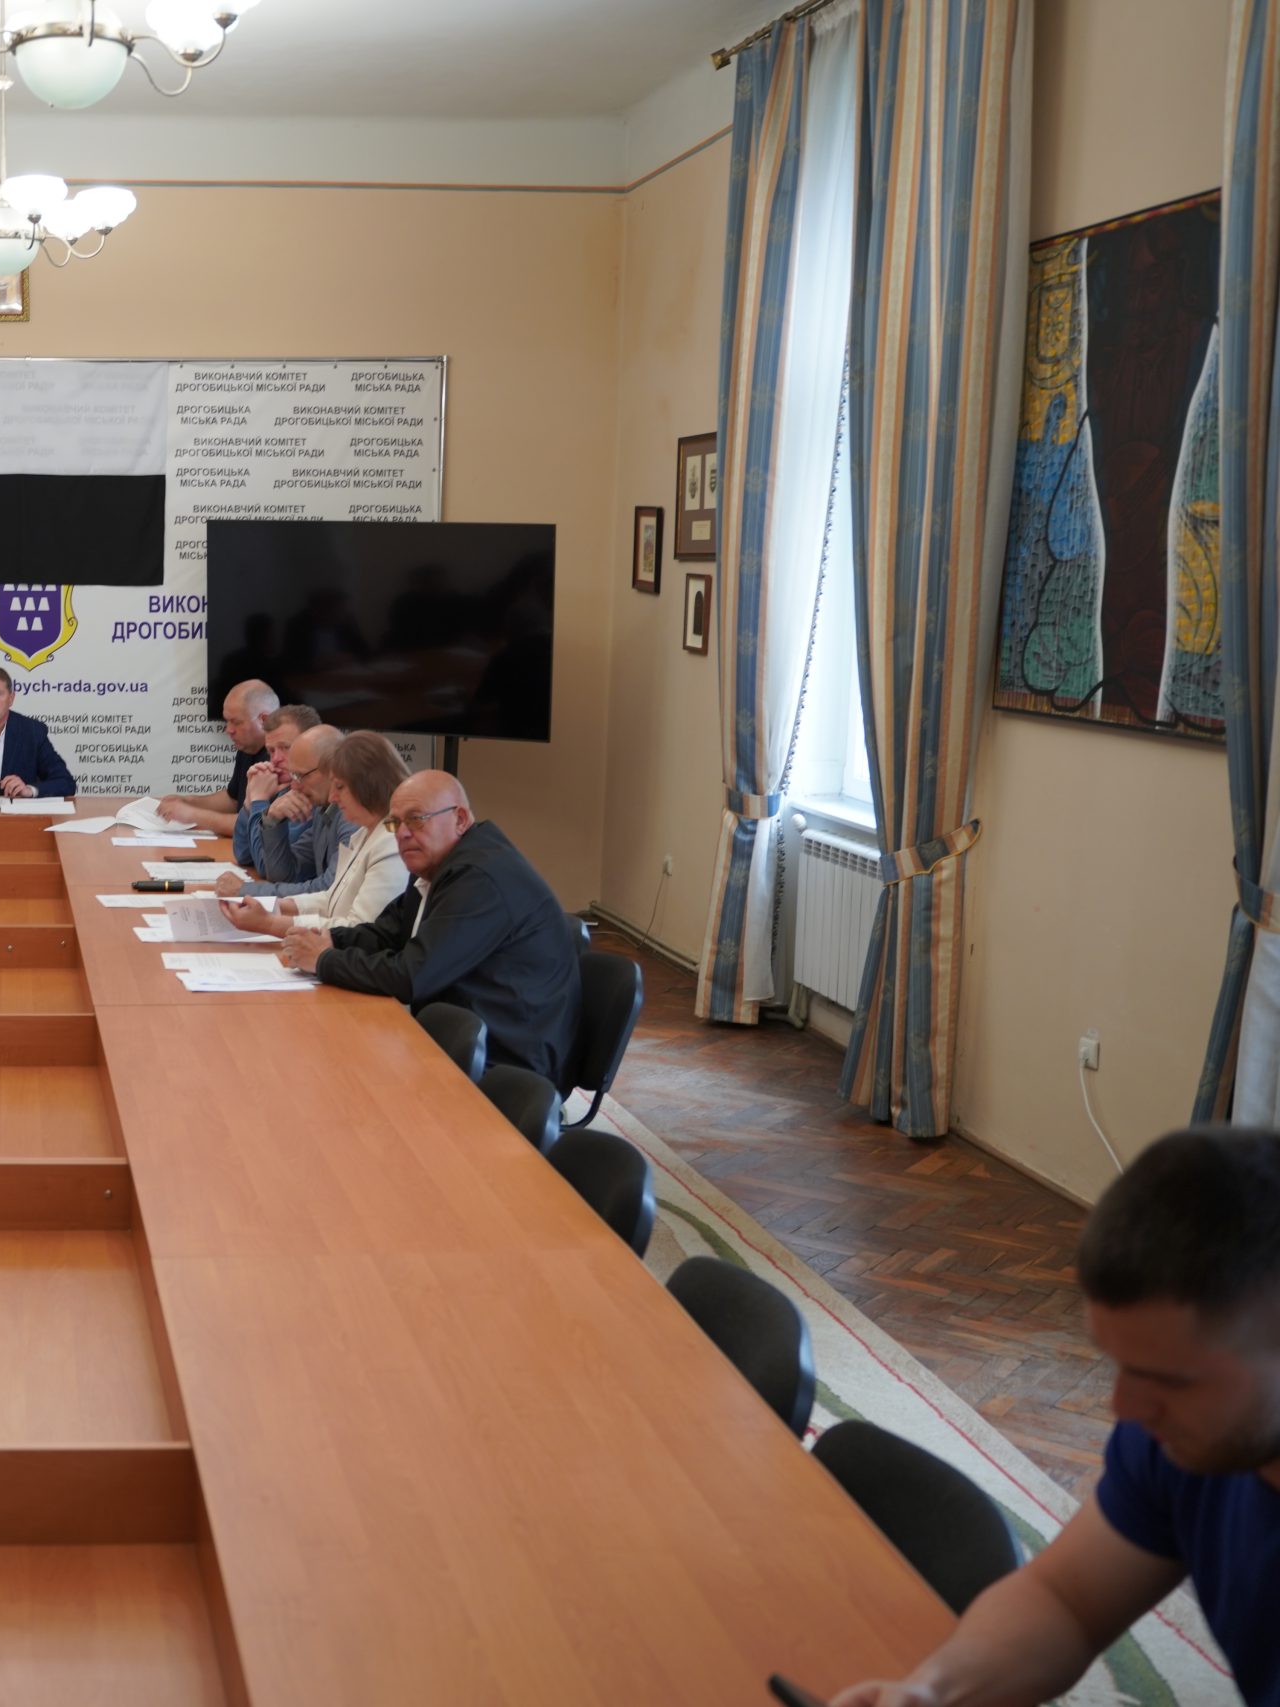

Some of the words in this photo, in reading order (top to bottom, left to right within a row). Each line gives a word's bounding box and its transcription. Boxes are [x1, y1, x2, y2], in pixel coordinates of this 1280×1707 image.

[195, 371, 262, 381] ВИКОНАВЧИЙ
[265, 372, 307, 381] КОМІТЕТ
[351, 372, 425, 382] ДРОГОБИЦЬКА
[176, 383, 253, 393] ДРОГОБИЦЬКОЇ
[256, 383, 297, 392] МІСЬКОЇ
[299, 383, 325, 393] РАДИ
[355, 383, 392, 392] МІСЬКА
[395, 384, 421, 394] РАДА
[176, 405, 251, 415] ДРОГОБИЦЬКА
[293, 406, 361, 415] ВИКОНАВЧИЙ
[364, 406, 405, 415] КОМІТЕТ
[181, 416, 218, 425] МІСЬКА
[220, 417, 247, 427] РАДА
[274, 417, 352, 427] ДРОГОБИЦЬКОЇ
[354, 416, 395, 426] МІСЬКОЇ
[397, 418, 423, 428] РАДИ
[194, 437, 262, 447] ВИКОНАВЧИЙ
[265, 437, 306, 447] КОМІТЕТ
[350, 438, 423, 448] ДРОГОБИЦЬКА
[175, 448, 252, 458] ДРОГОБИЦЬКОЇ
[255, 448, 296, 458] МІСЬКОЇ
[298, 449, 324, 459] РАДИ
[354, 448, 390, 458] МІСЬКА
[393, 449, 419, 459] РАДА
[176, 468, 250, 478] ДРОГОБИЦЬКА
[292, 468, 360, 478] ВИКОНАВЧИЙ
[363, 468, 403, 478] КОМІТЕТ
[180, 478, 217, 488] МІСЬКА
[220, 479, 246, 489] РАДА
[273, 479, 351, 489] ДРОГОБИЦЬКОЇ
[353, 479, 393, 489] МІСЬКОЇ
[396, 480, 422, 490] РАДИ
[193, 504, 261, 514] ВИКОНАВЧИЙ
[264, 504, 305, 514] КОМІТЕТ
[349, 504, 422, 514] ДРОГОБИЦЬКА
[112, 621, 207, 643] ДРОГОБИ
[29, 713, 88, 723] КОНАВЧИЙ
[91, 714, 132, 724] КОМІТЕТ
[82, 725, 122, 735] МІСЬКОЇ
[125, 725, 151, 735] РАДИ
[177, 724, 215, 734] МІСЬКА
[75, 744, 148, 754] ДРОГОБИЦЬКА
[190, 744, 237, 754] ВИКОНАВ
[79, 754, 115, 764] МІСЬКА
[119, 755, 144, 765] РАДА
[171, 755, 236, 765] ДРОГОБИЦЬ
[91, 774, 132, 784] КОМІТЕТ
[82, 785, 122, 794] МІСЬКОЇ
[124, 786, 150, 797] РАДИ
[177, 784, 212, 794] МІСЬКА
